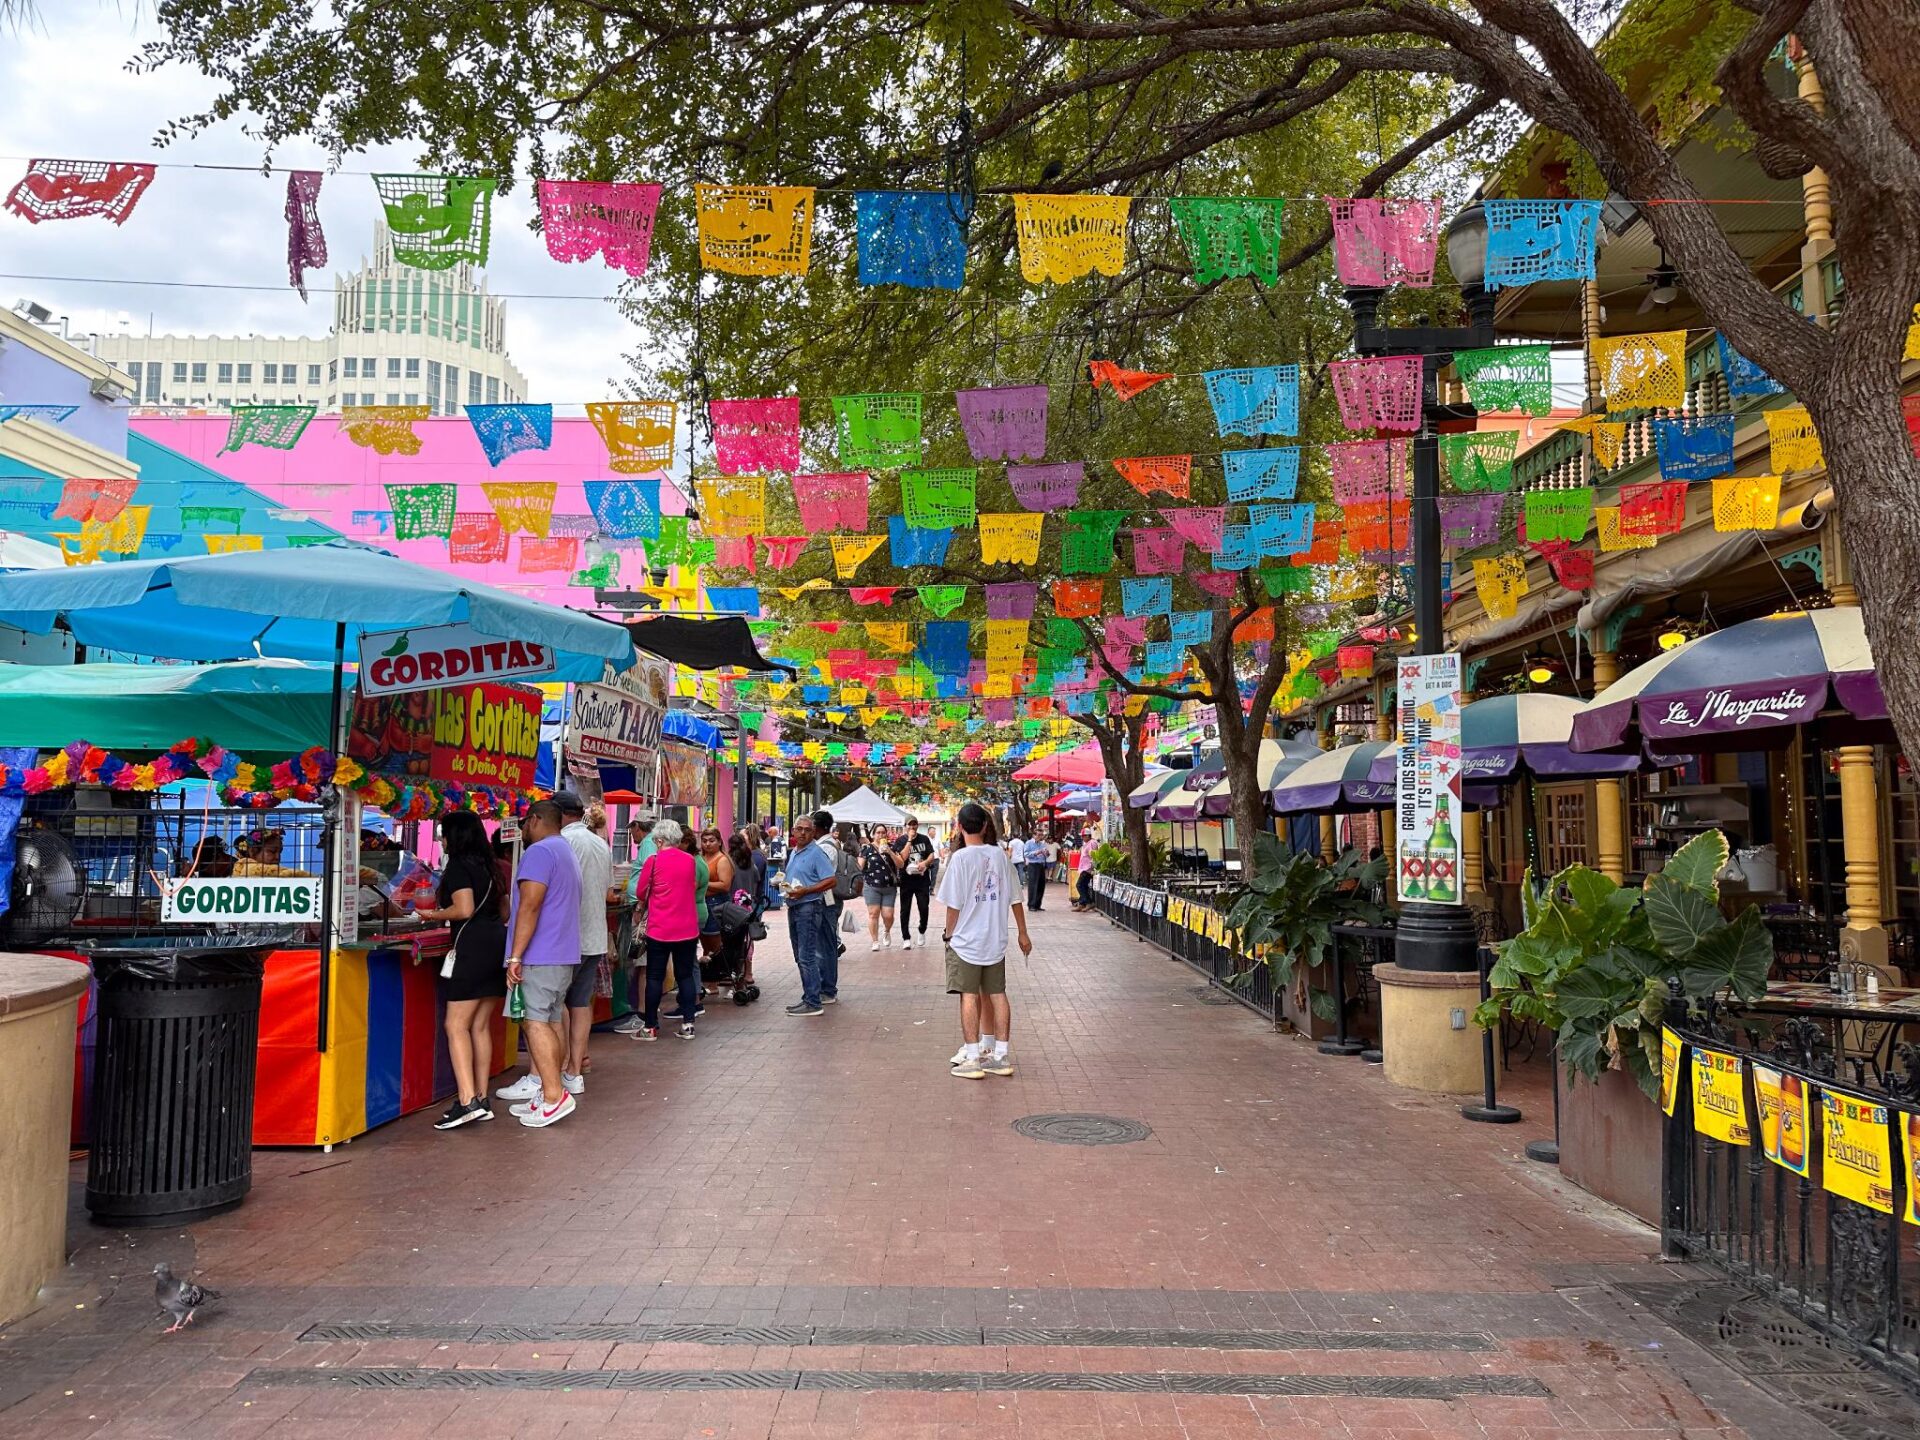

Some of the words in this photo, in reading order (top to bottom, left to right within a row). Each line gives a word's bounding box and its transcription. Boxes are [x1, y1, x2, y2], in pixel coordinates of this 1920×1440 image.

[370, 640, 544, 686] GORDITAS
[1432, 656, 1456, 669] FIESTA
[574, 688, 618, 740] Sausage
[1402, 696, 1416, 743] ANTONIO,
[1660, 702, 1694, 725] La
[1689, 688, 1806, 727] Margarita
[434, 688, 464, 746] Las
[470, 686, 539, 759] Gorditas
[1418, 718, 1432, 744] TIME
[582, 739, 627, 758] SAUSAGE
[1402, 745, 1415, 767] SAN
[452, 754, 465, 771] de
[467, 755, 497, 776] Doña
[1418, 749, 1432, 786] FIESTA
[1402, 770, 1415, 790] DOS
[1418, 788, 1432, 809] IT'S
[1402, 803, 1415, 831] GRAB
[177, 886, 310, 914] GORDITAS
